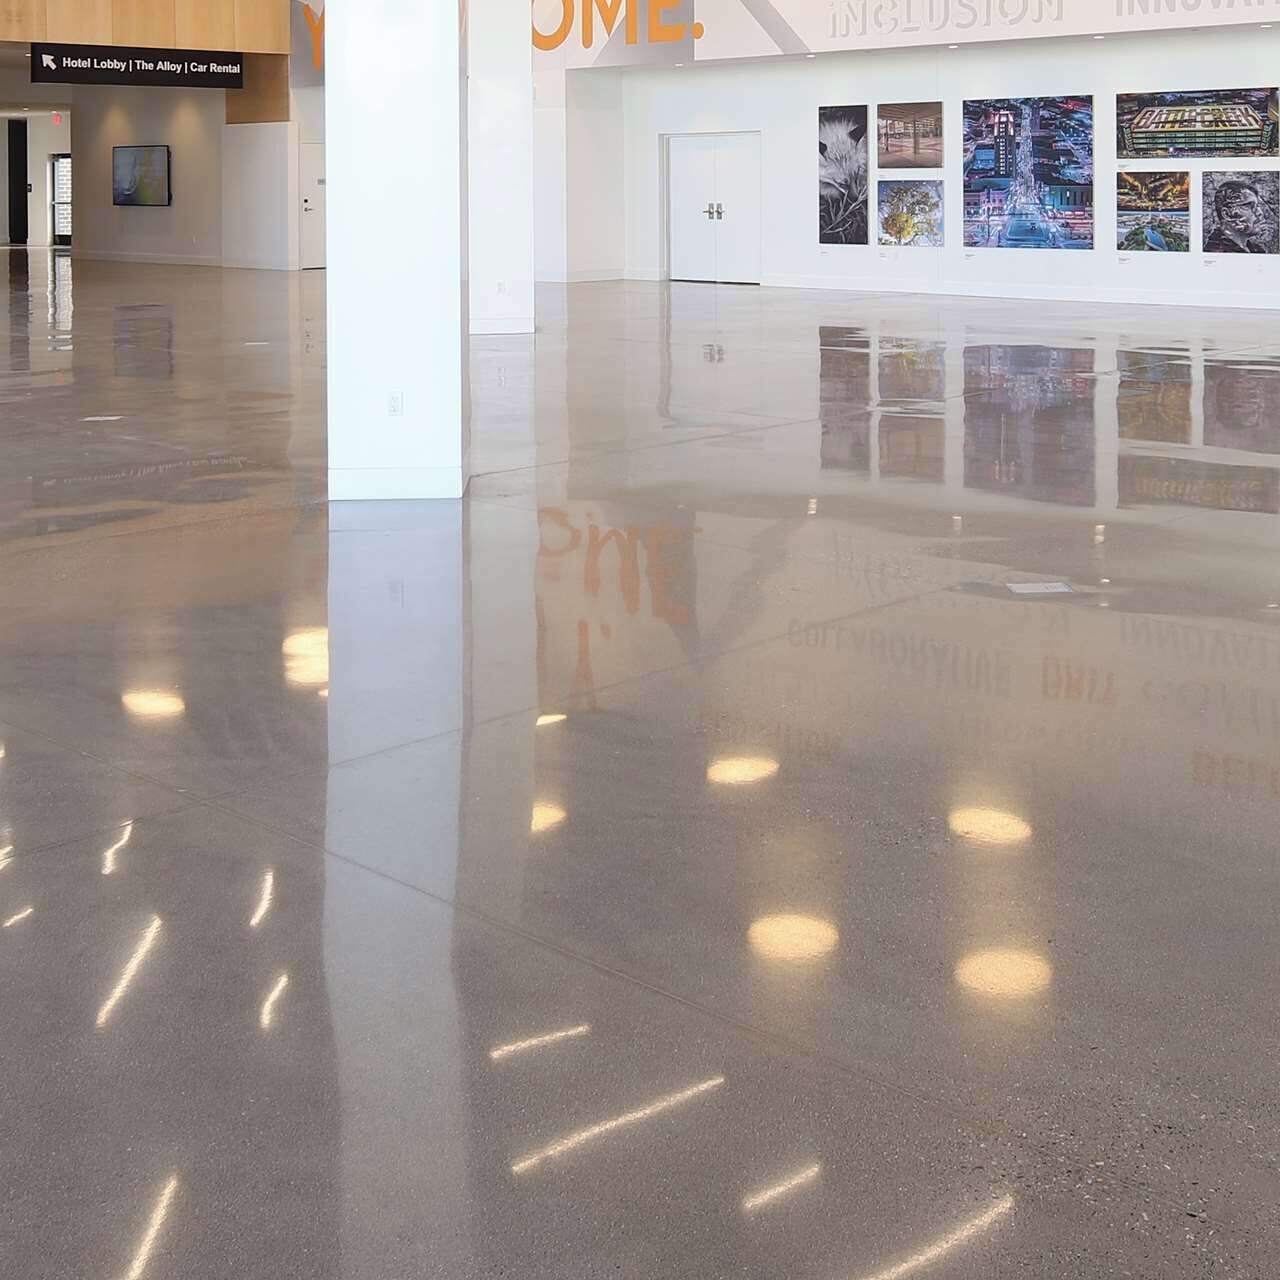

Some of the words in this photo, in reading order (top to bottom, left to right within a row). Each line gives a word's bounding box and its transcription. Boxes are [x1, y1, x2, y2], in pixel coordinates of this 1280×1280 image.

[62, 57, 91, 68] Hotel
[94, 58, 127, 72] Lobby
[135, 60, 154, 70] The
[156, 61, 182, 73] Alloy
[190, 63, 207, 73] Car
[210, 63, 241, 74] Rental
